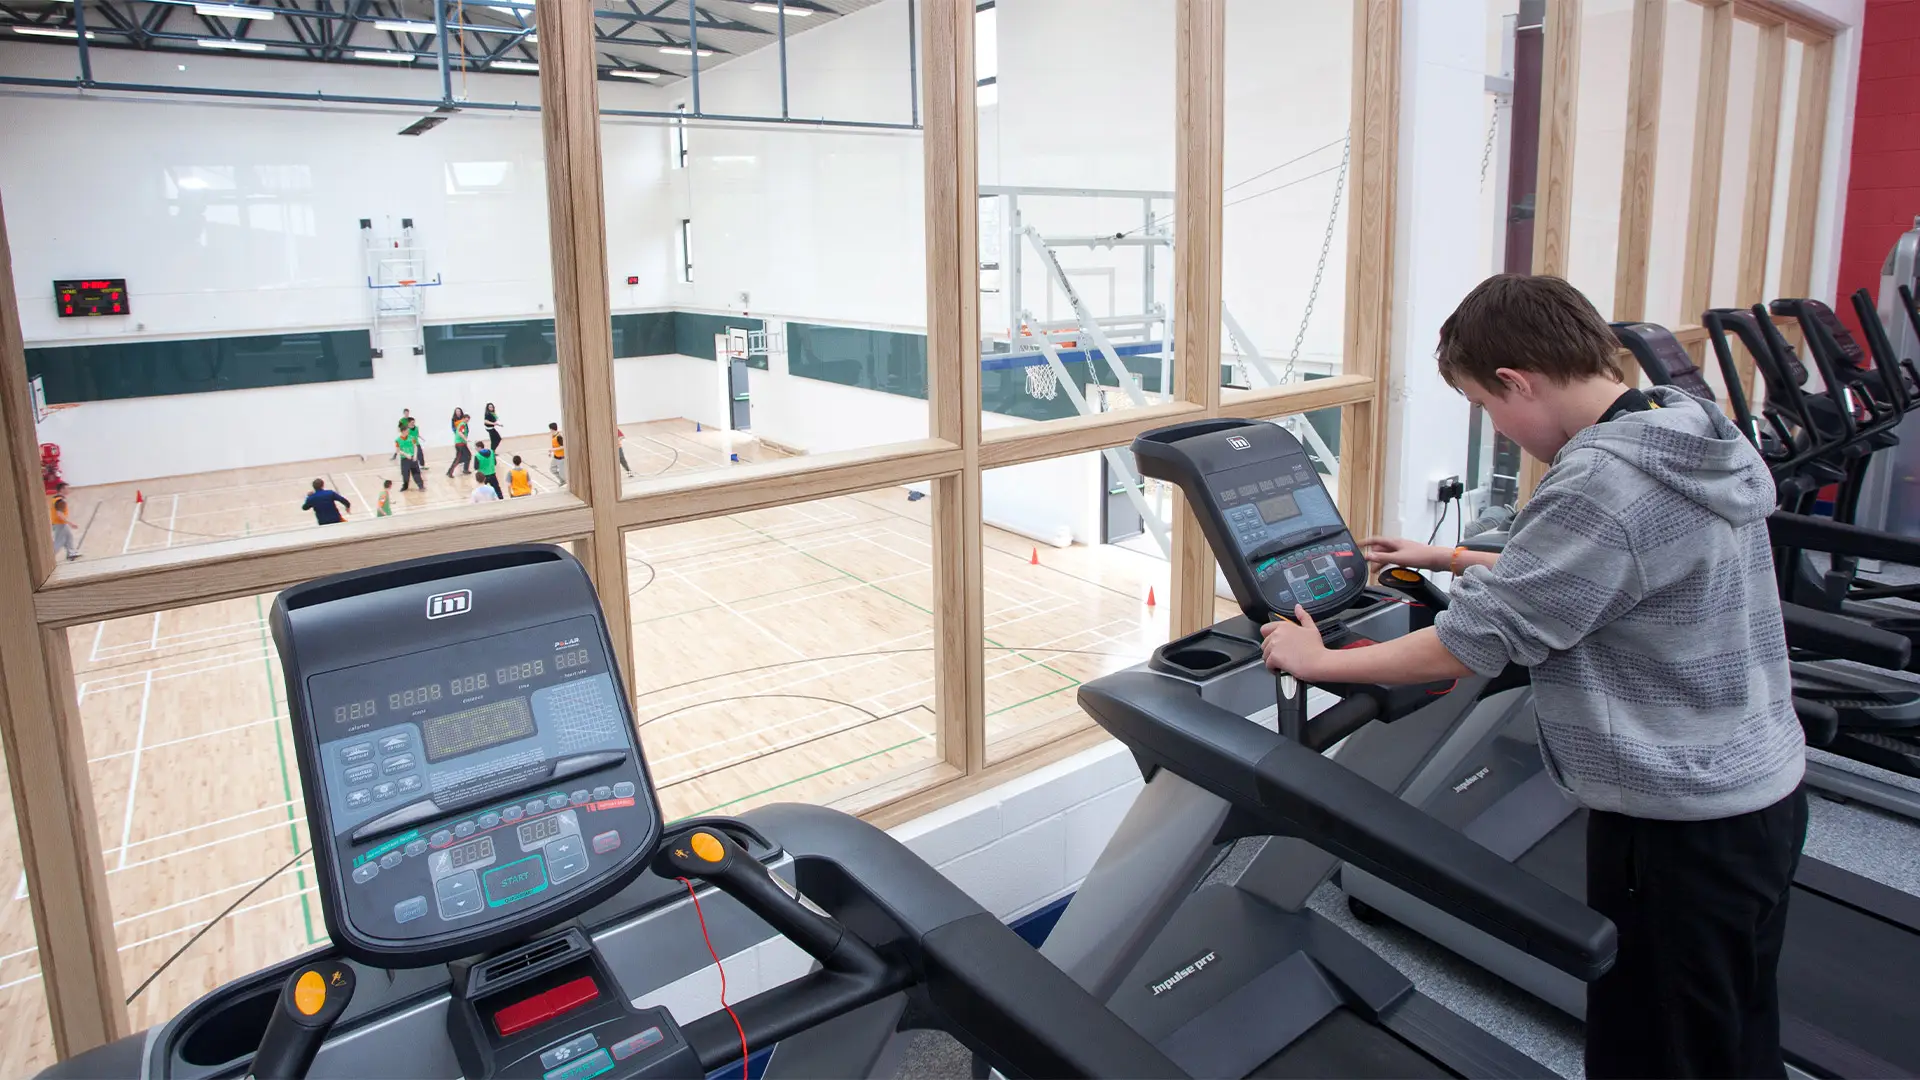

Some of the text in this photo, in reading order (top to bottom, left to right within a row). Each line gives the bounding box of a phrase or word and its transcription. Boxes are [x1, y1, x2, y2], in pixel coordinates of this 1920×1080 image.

[554, 637, 580, 648] POLAR
[1452, 766, 1489, 793] impulse pro
[500, 872, 529, 888] START
[1152, 951, 1215, 996] impulse pro
[561, 1060, 597, 1080] START
